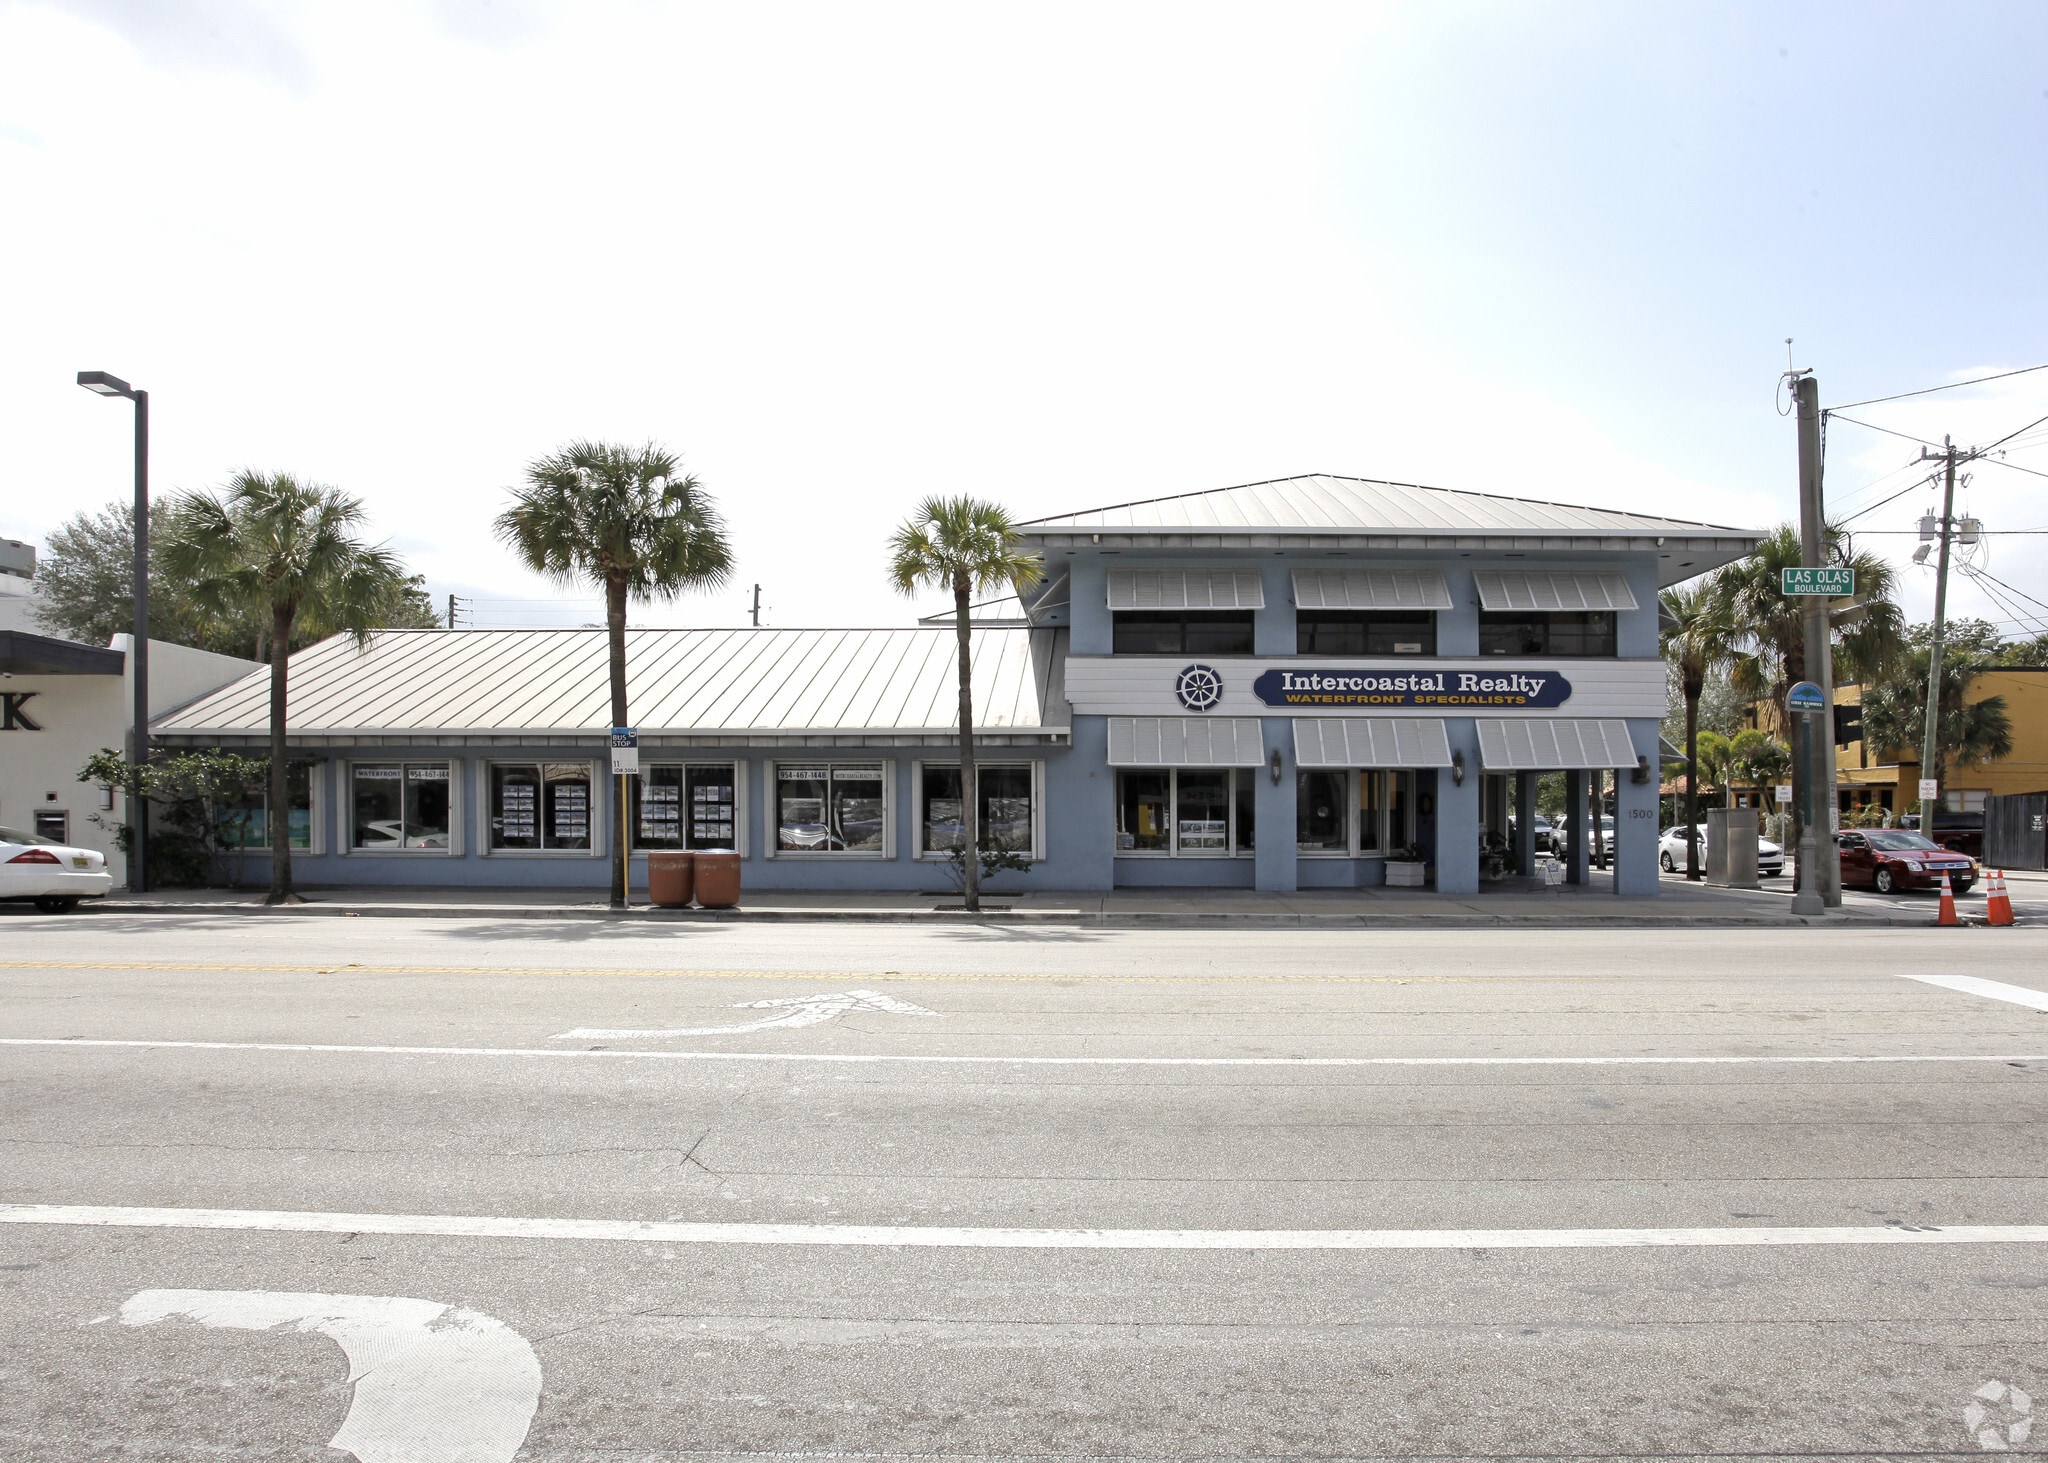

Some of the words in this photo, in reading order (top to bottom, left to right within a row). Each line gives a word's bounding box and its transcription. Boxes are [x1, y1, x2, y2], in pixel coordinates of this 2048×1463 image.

[1786, 570, 1812, 584] LAS
[1817, 570, 1850, 584] OLAS
[1794, 584, 1842, 593] BOULEVARD
[1282, 672, 1445, 691] Intercoastal
[1458, 673, 1546, 698] Realty
[1285, 694, 1405, 704] WATERFRONT
[1414, 695, 1527, 704] SPECIALISTS
[613, 760, 620, 768] 11
[358, 769, 400, 777] WATERFRONT
[780, 771, 827, 779] 954-467-1448
[1628, 809, 1654, 819] 1500
